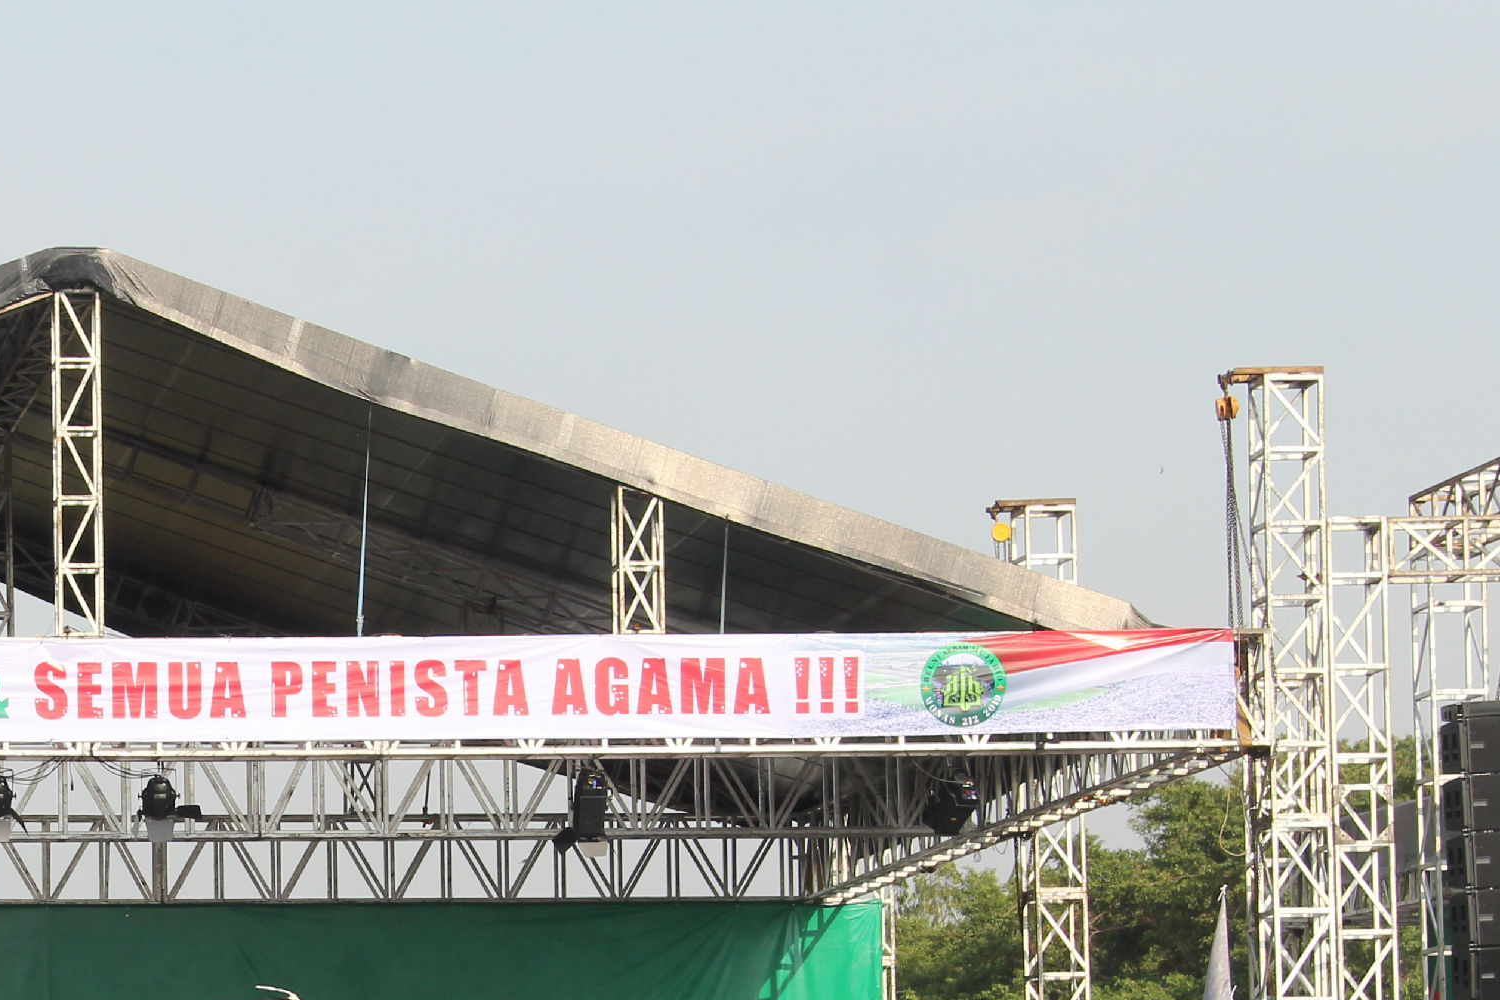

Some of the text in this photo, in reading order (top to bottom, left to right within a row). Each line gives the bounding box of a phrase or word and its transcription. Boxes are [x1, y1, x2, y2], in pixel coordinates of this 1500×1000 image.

[35, 661, 246, 719] SEMUA
[271, 660, 527, 717] PENISTA
[553, 658, 770, 716] AGAMA
[796, 657, 858, 714] !!!
[924, 695, 956, 725] MONAS
[961, 715, 980, 726] 212
